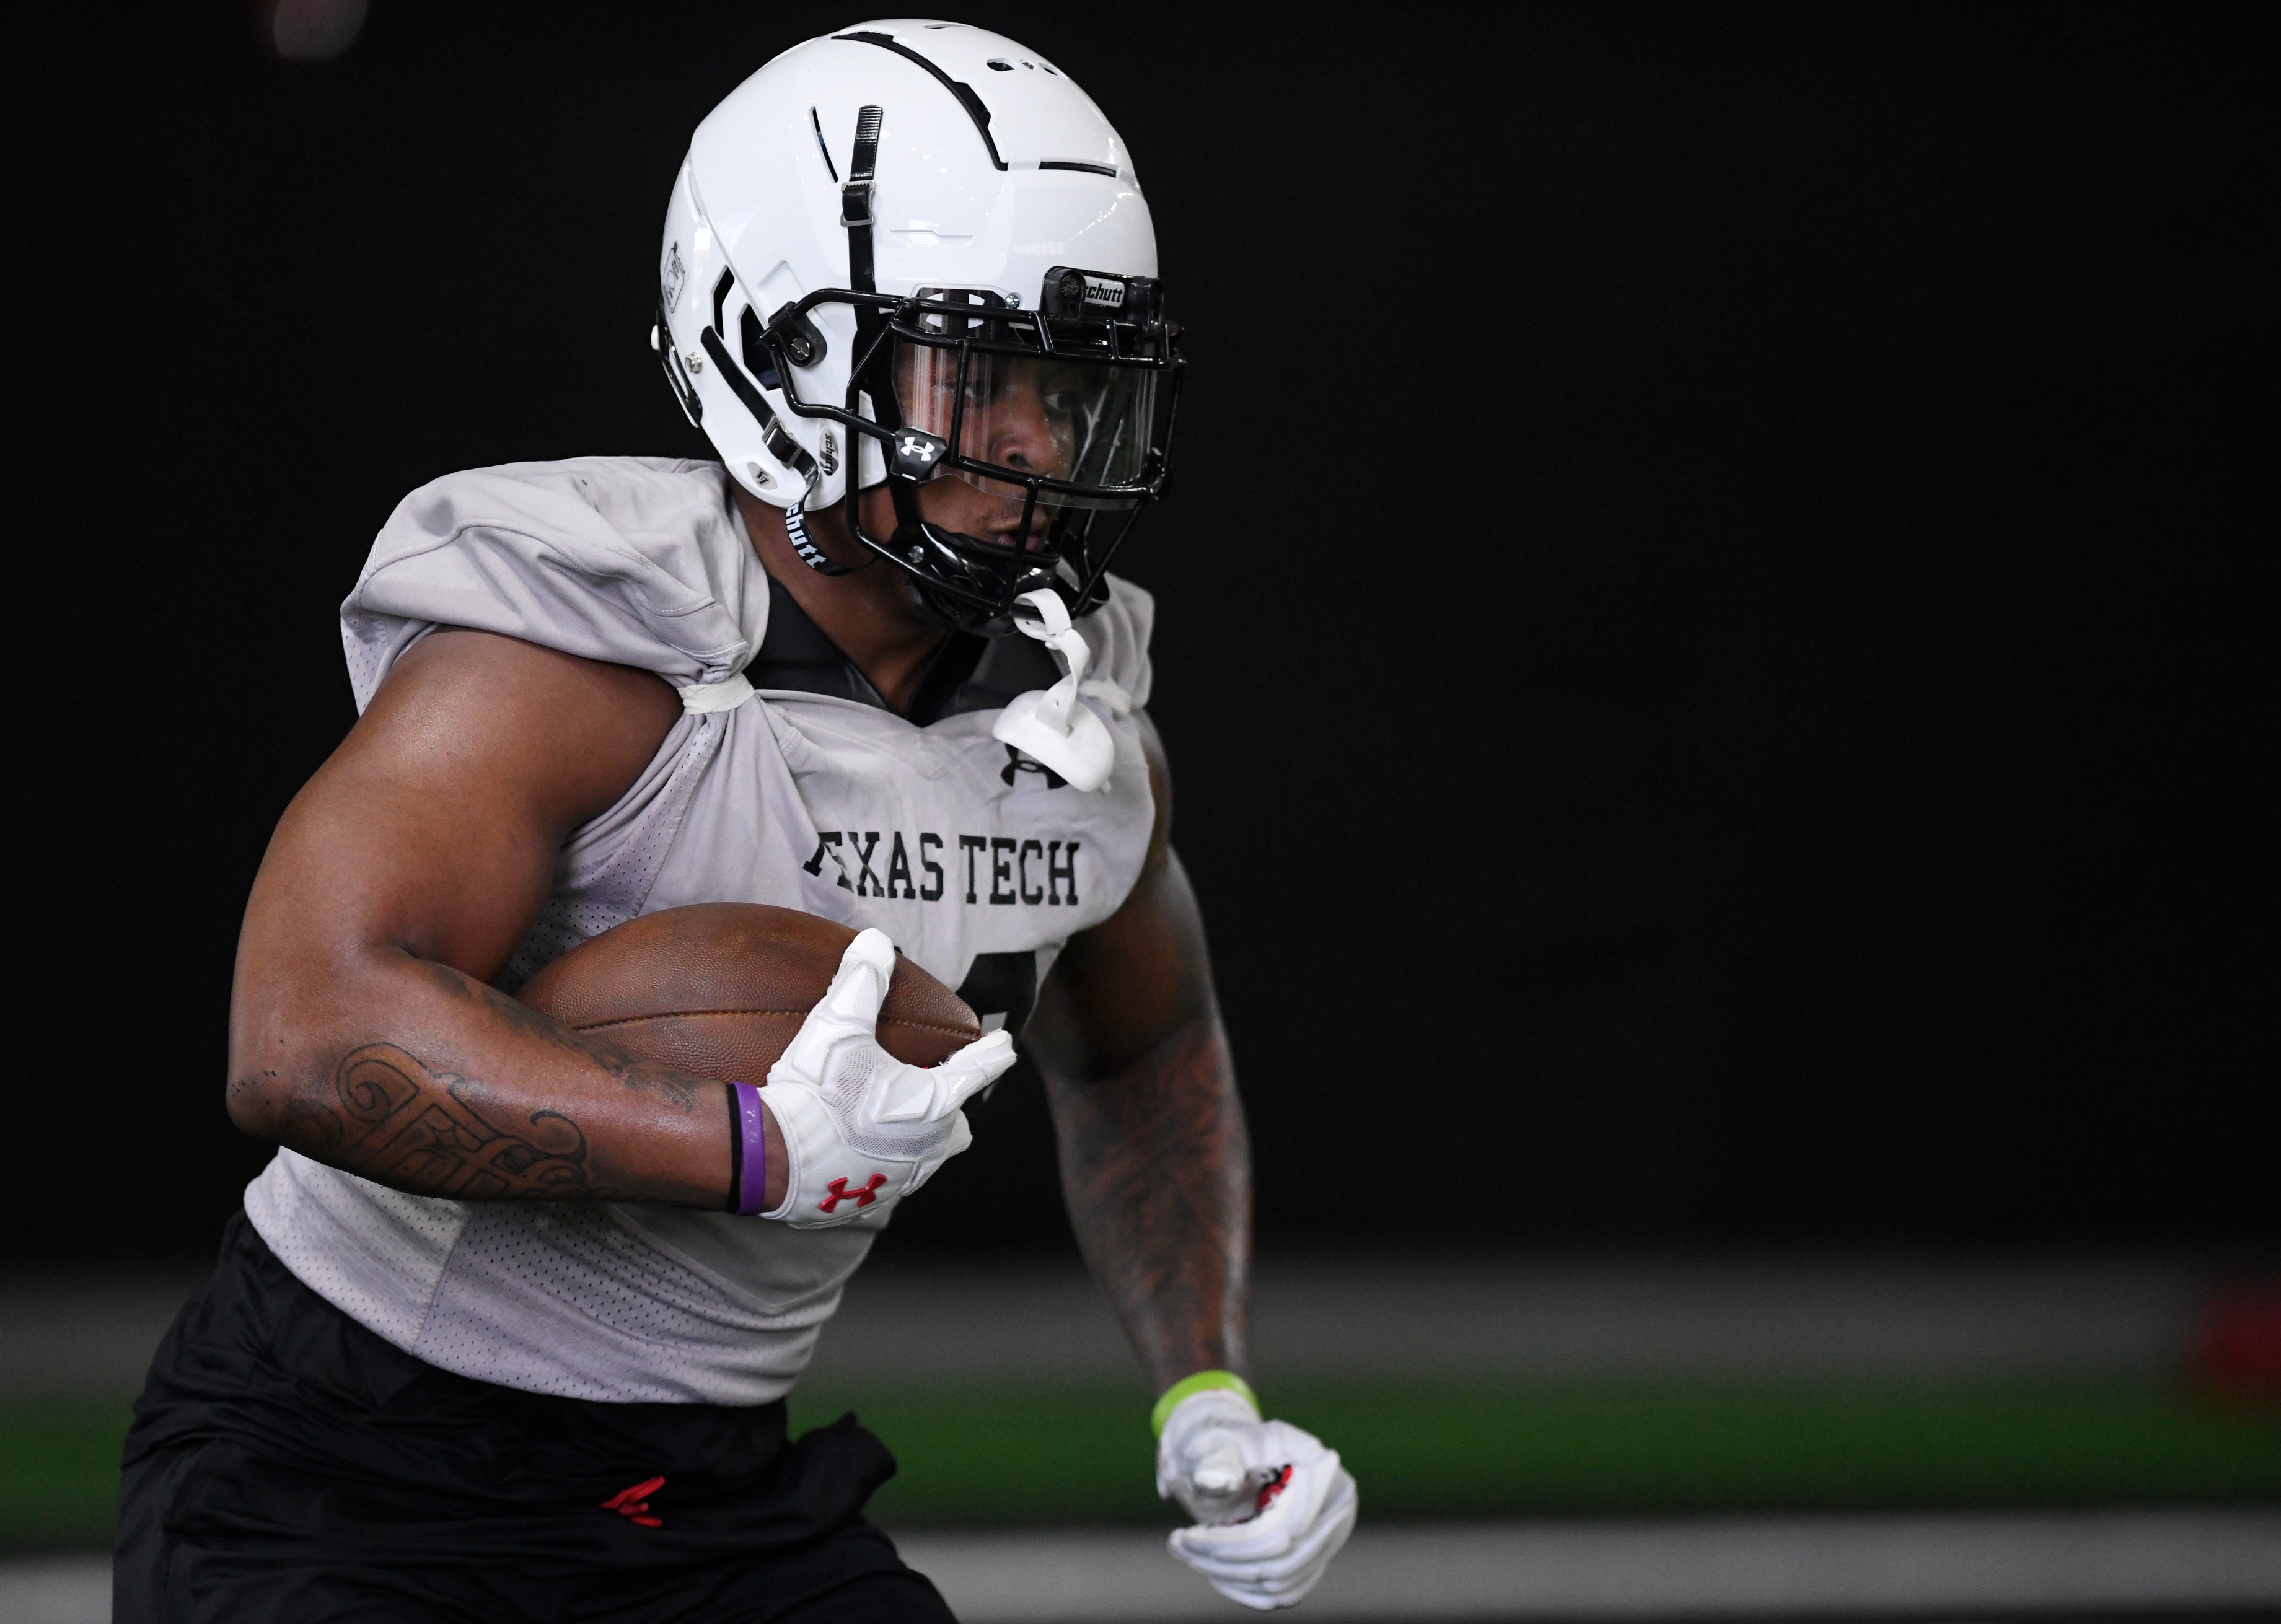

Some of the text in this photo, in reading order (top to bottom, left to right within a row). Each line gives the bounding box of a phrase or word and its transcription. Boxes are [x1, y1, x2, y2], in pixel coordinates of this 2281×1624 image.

[825, 433, 835, 472] schutt
[785, 503, 827, 568] chutt
[959, 835, 1080, 905] TECH
